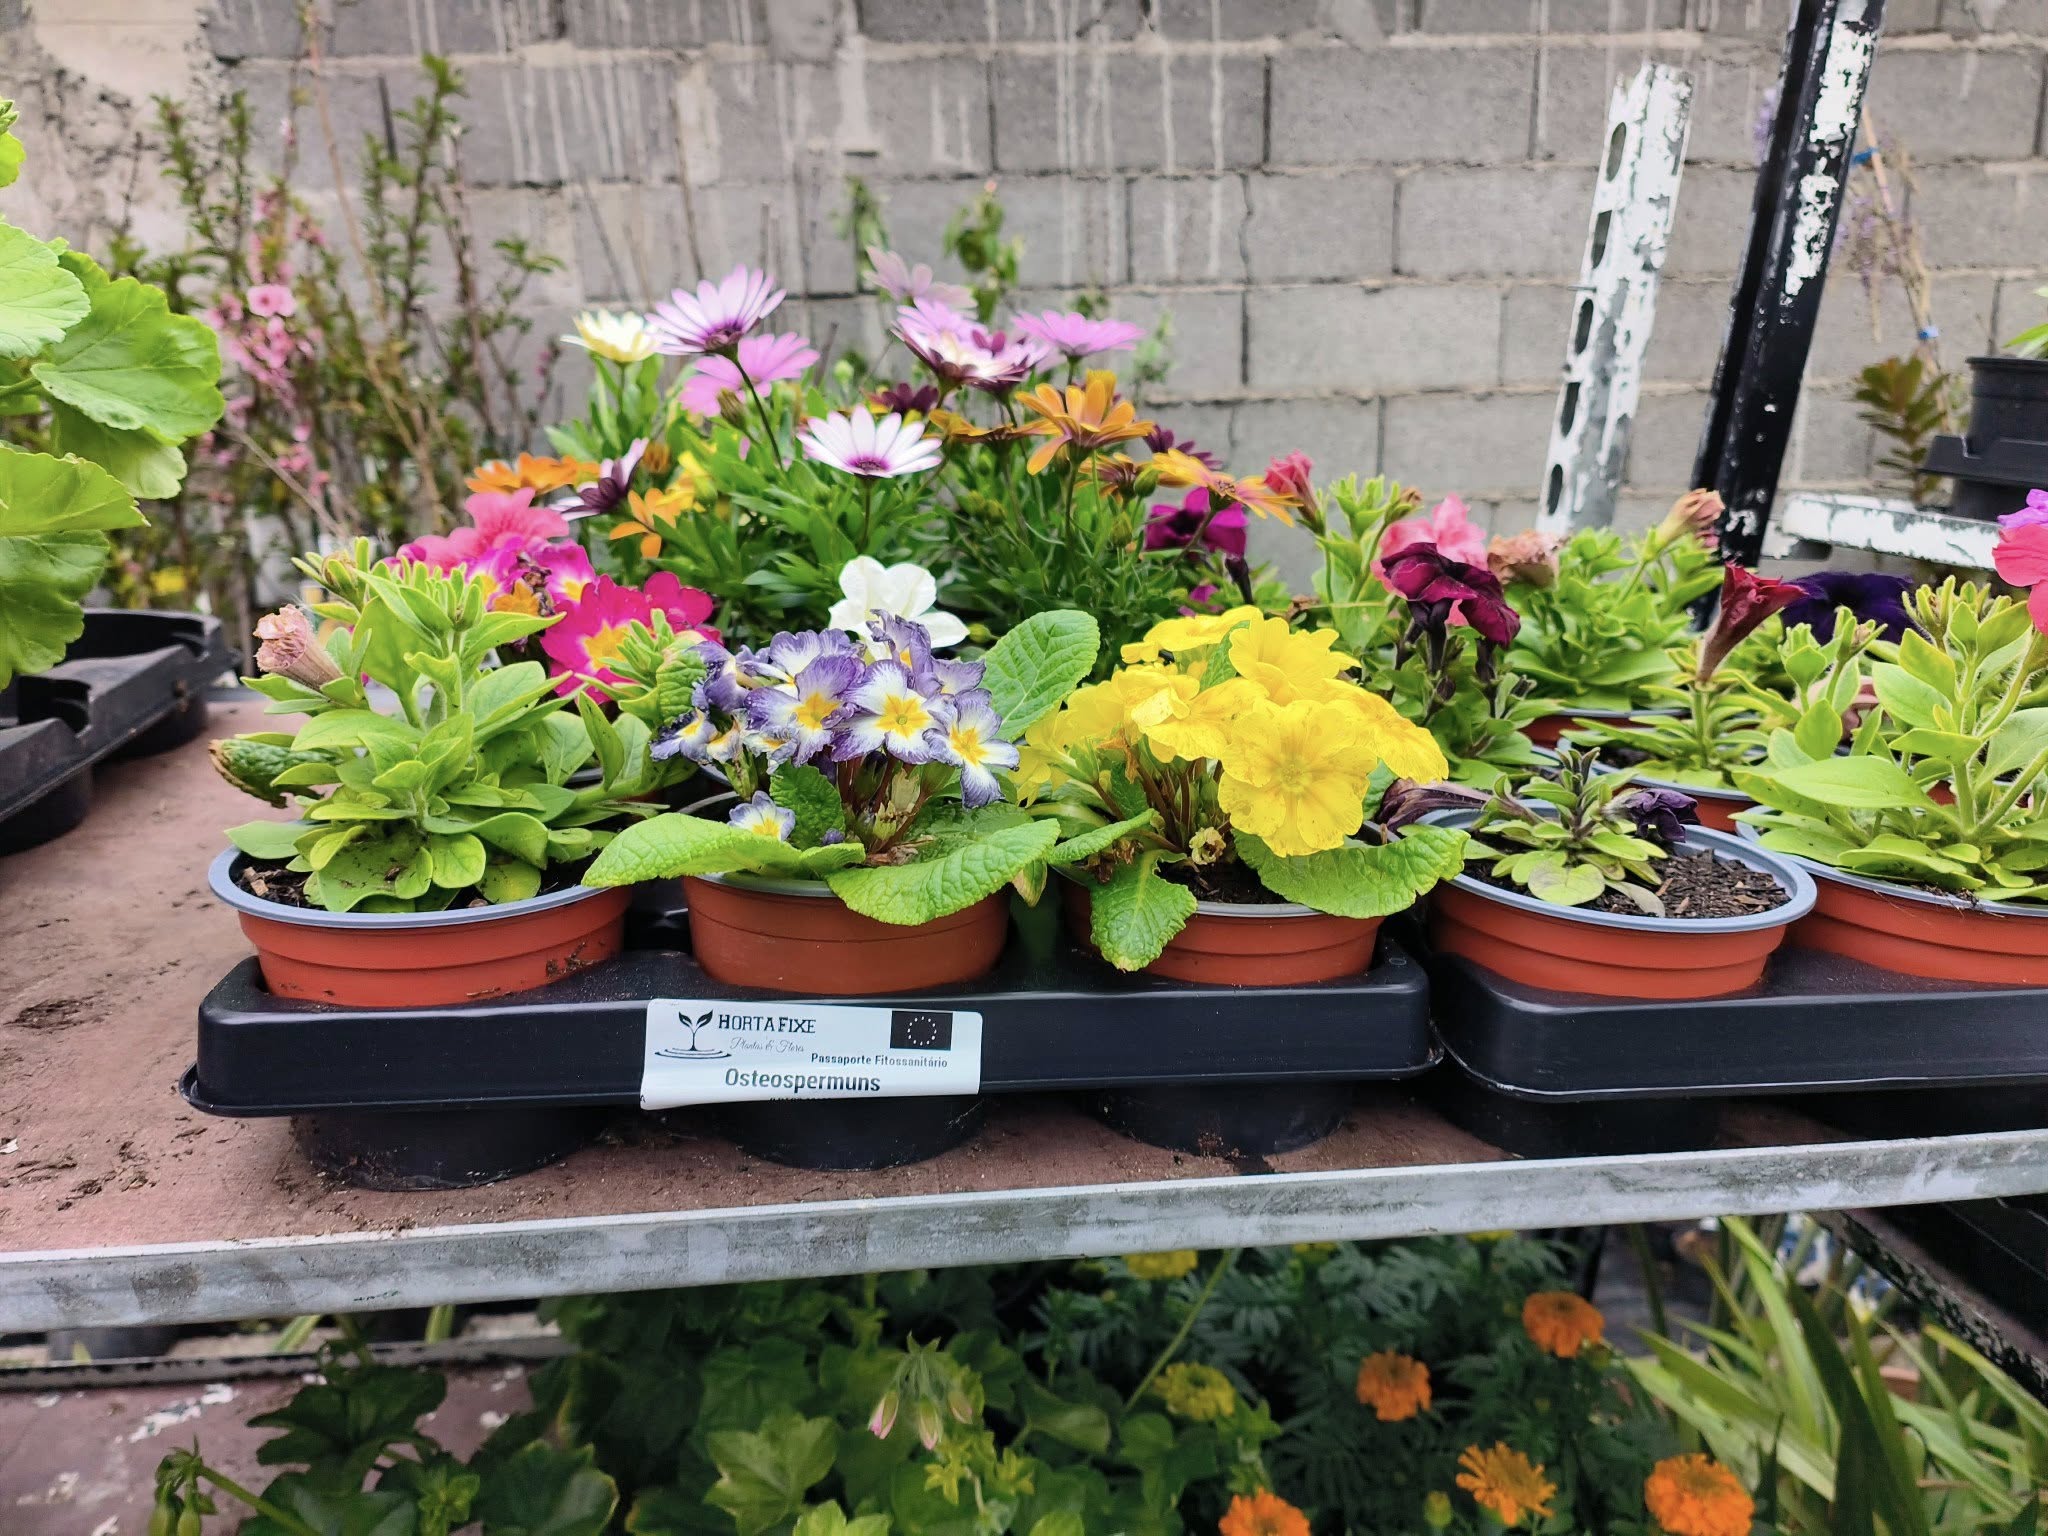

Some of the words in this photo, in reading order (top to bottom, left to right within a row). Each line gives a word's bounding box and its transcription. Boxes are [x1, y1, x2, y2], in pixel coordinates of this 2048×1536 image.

[811, 1052, 872, 1066] Passaporte
[874, 1054, 948, 1068] Fitossanitário
[725, 1068, 881, 1094] Osteospermuns
